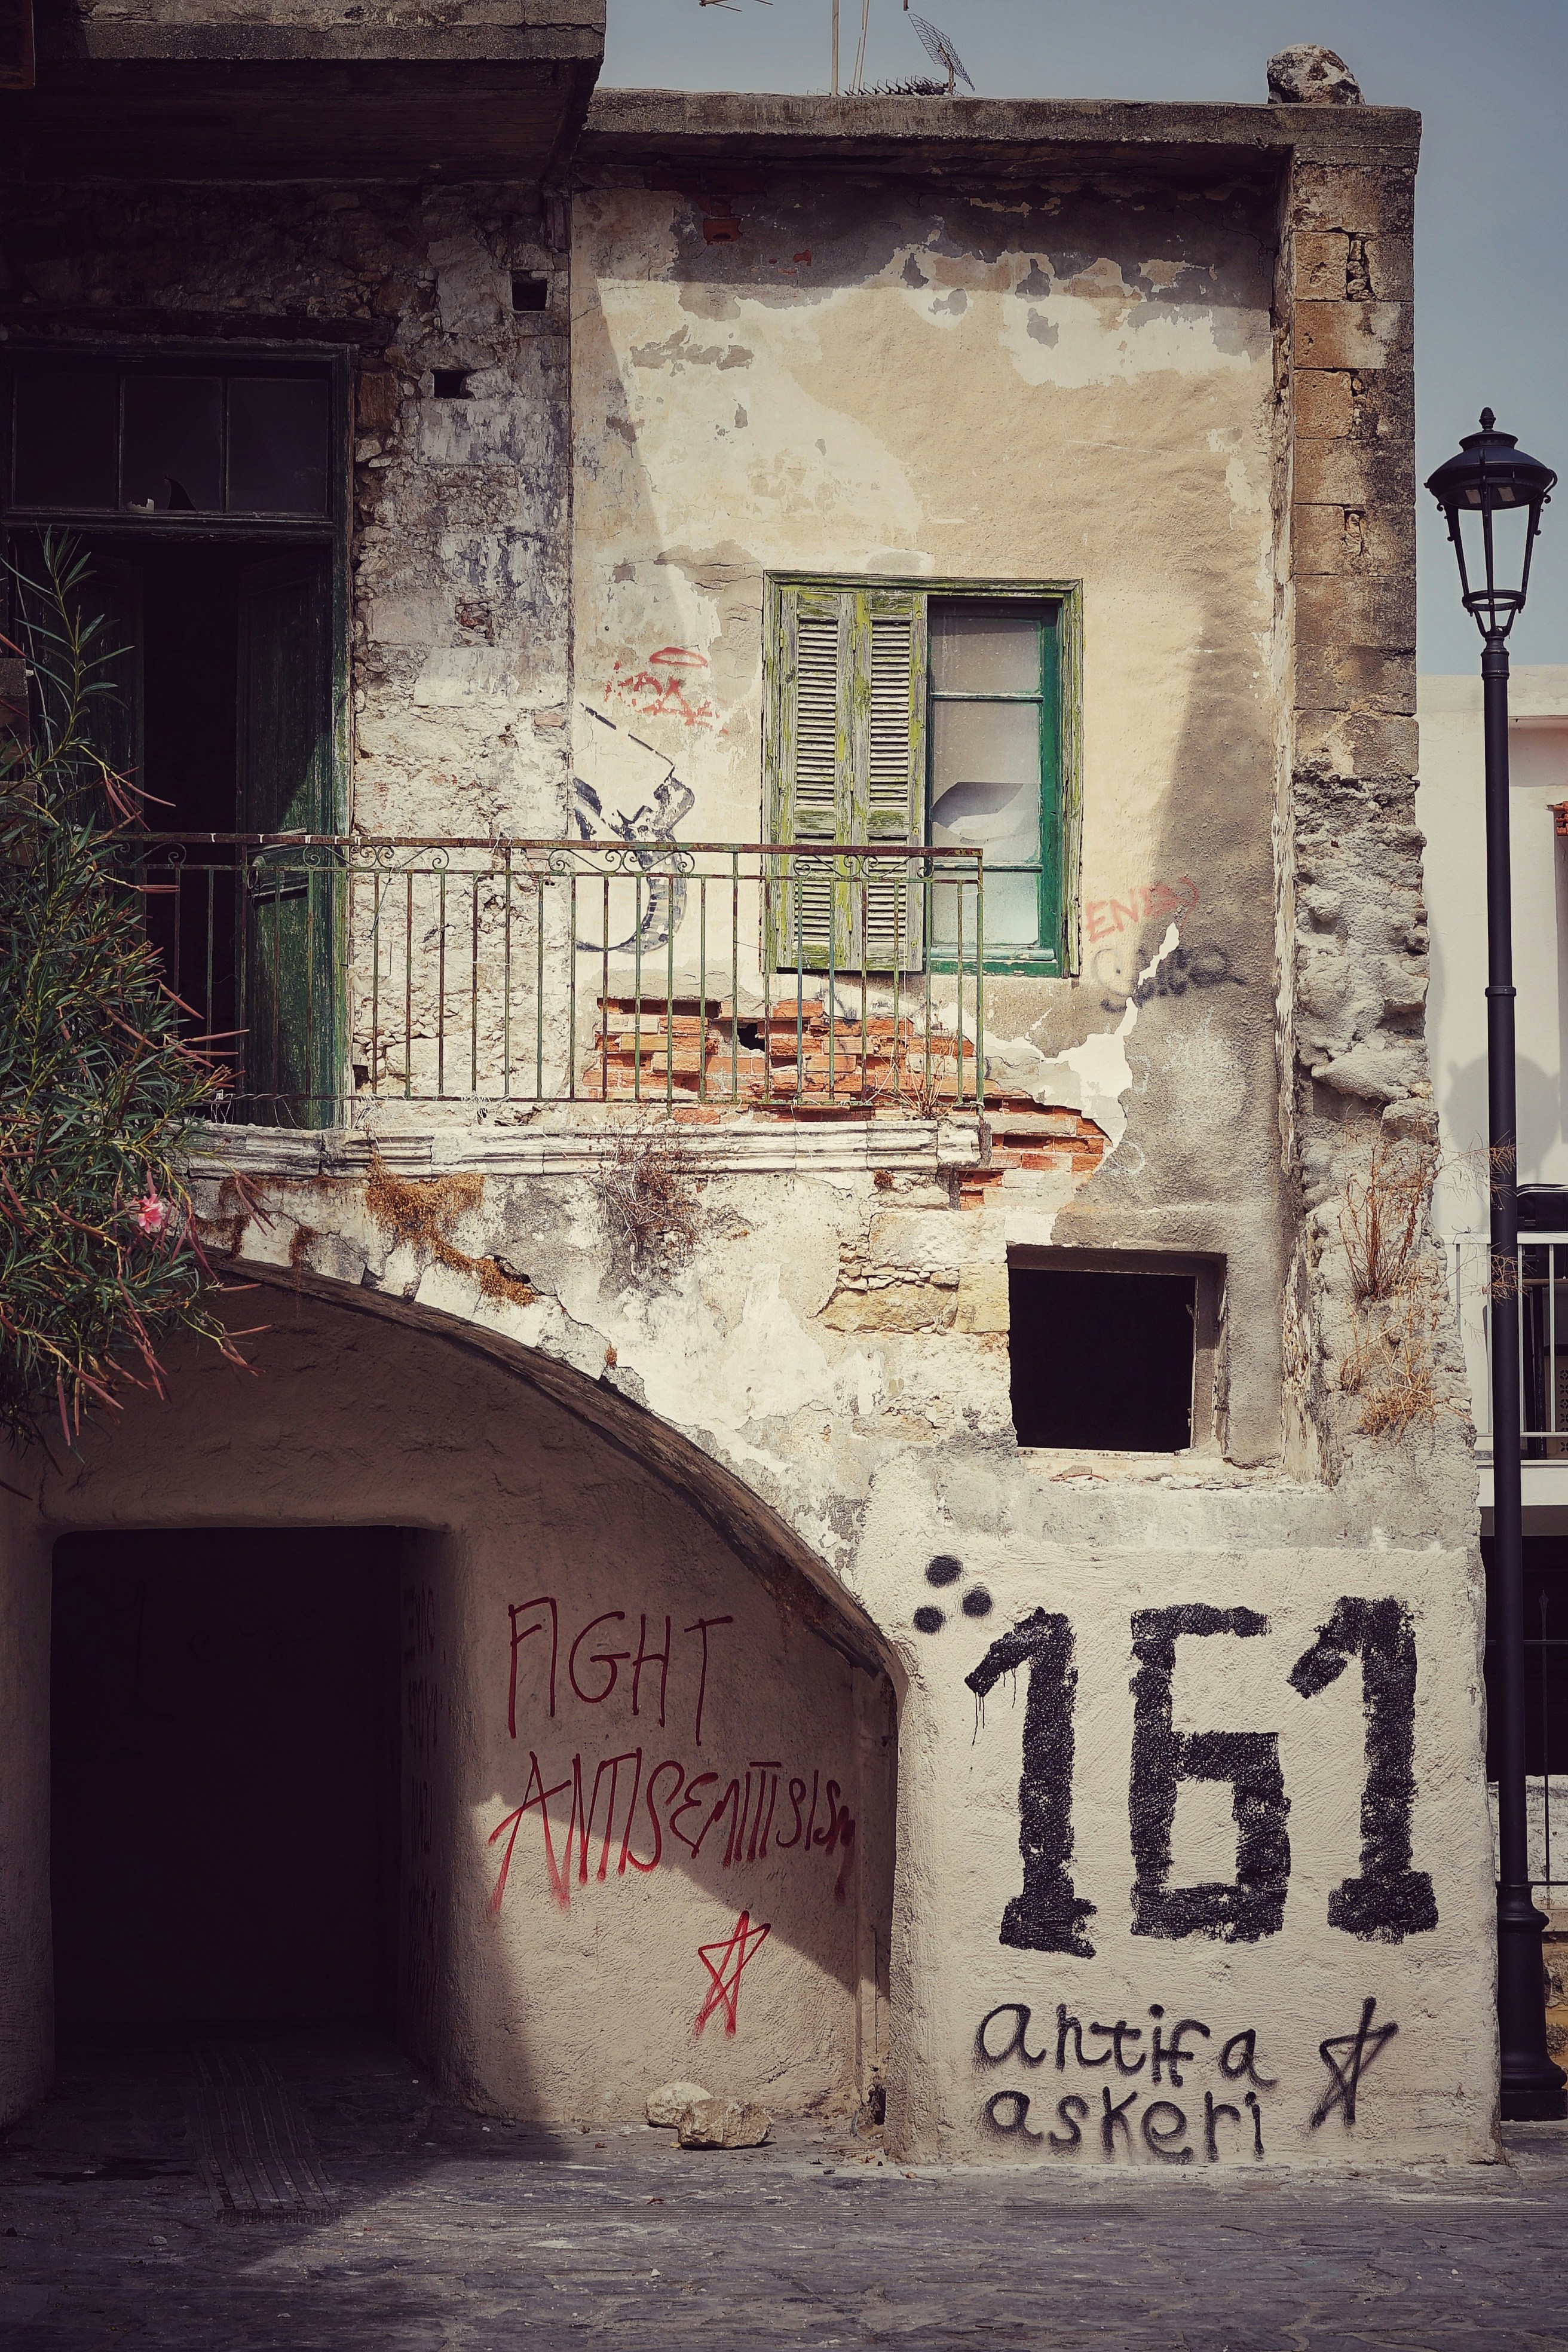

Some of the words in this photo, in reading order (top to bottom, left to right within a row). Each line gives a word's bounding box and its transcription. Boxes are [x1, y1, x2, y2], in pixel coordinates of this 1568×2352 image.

[509, 1596, 734, 1747] FIGHT
[964, 1595, 1439, 1959] 161
[973, 2002, 1278, 2090] antifa
[980, 2085, 1265, 2163] askeri
